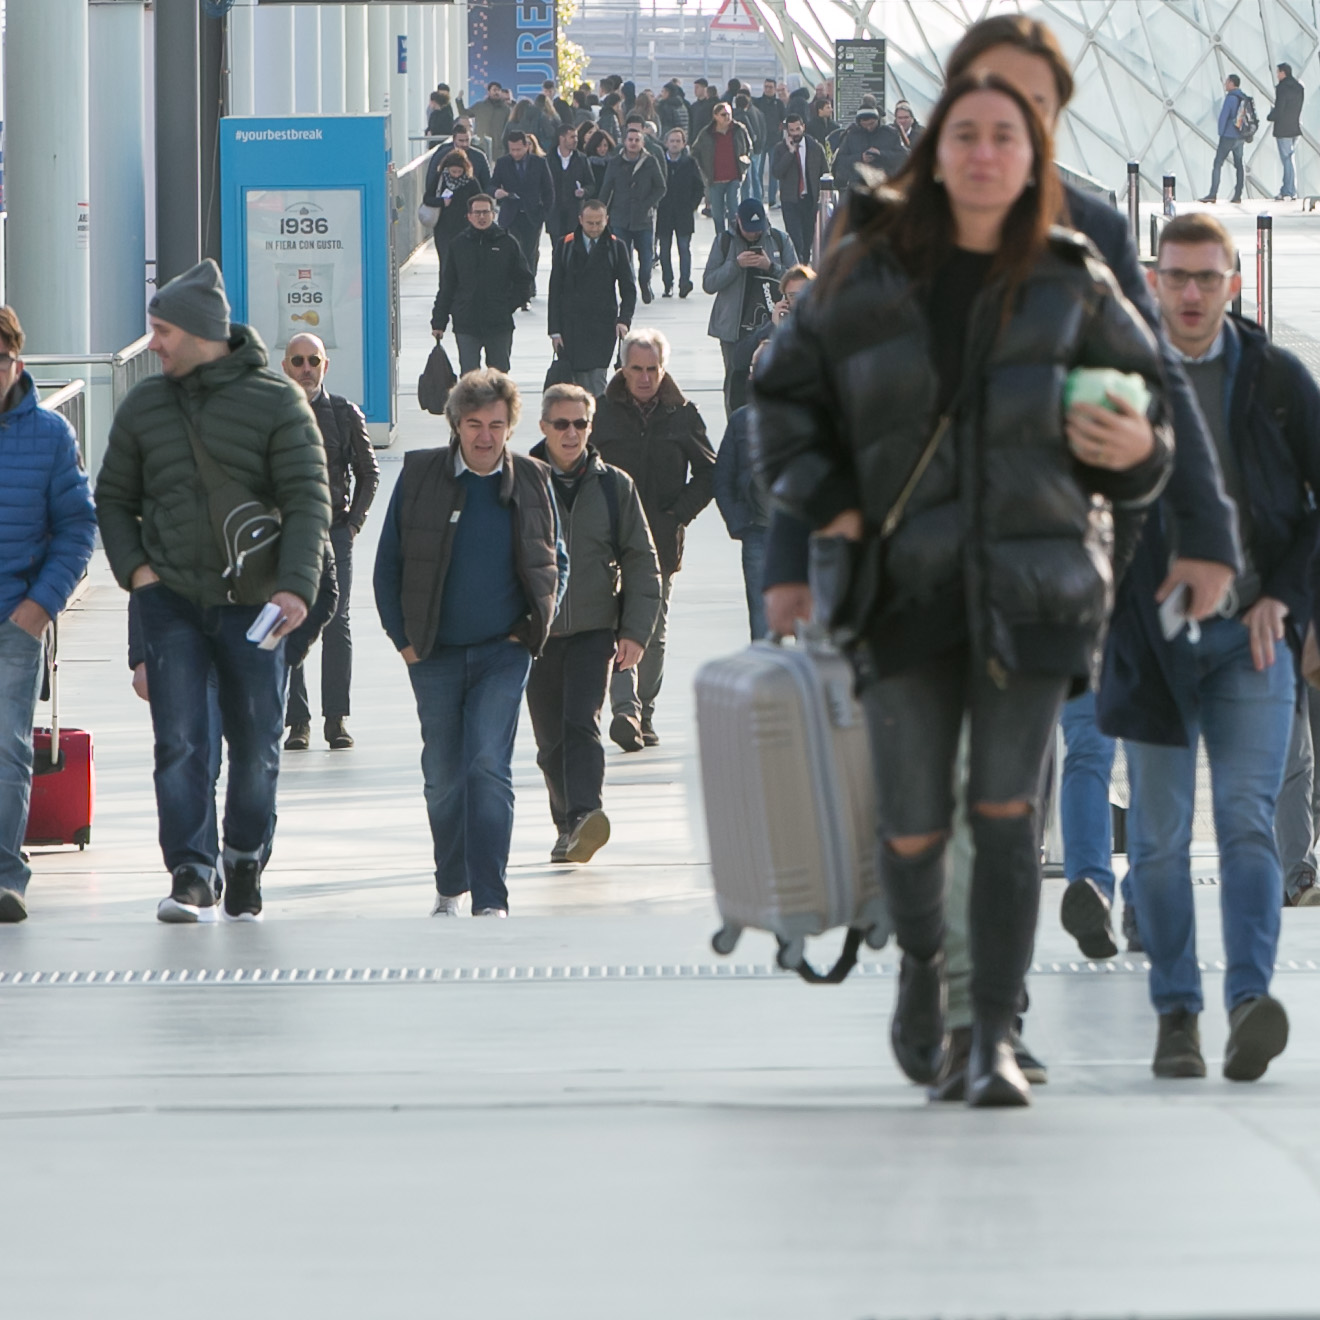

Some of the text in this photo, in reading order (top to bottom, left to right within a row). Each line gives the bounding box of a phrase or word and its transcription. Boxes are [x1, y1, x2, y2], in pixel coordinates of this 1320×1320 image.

[235, 129, 323, 142] #yourbestbreak
[280, 218, 329, 235] 1936
[266, 240, 344, 250] IN FIERA CON GUSTO.
[288, 292, 323, 304] 1936
